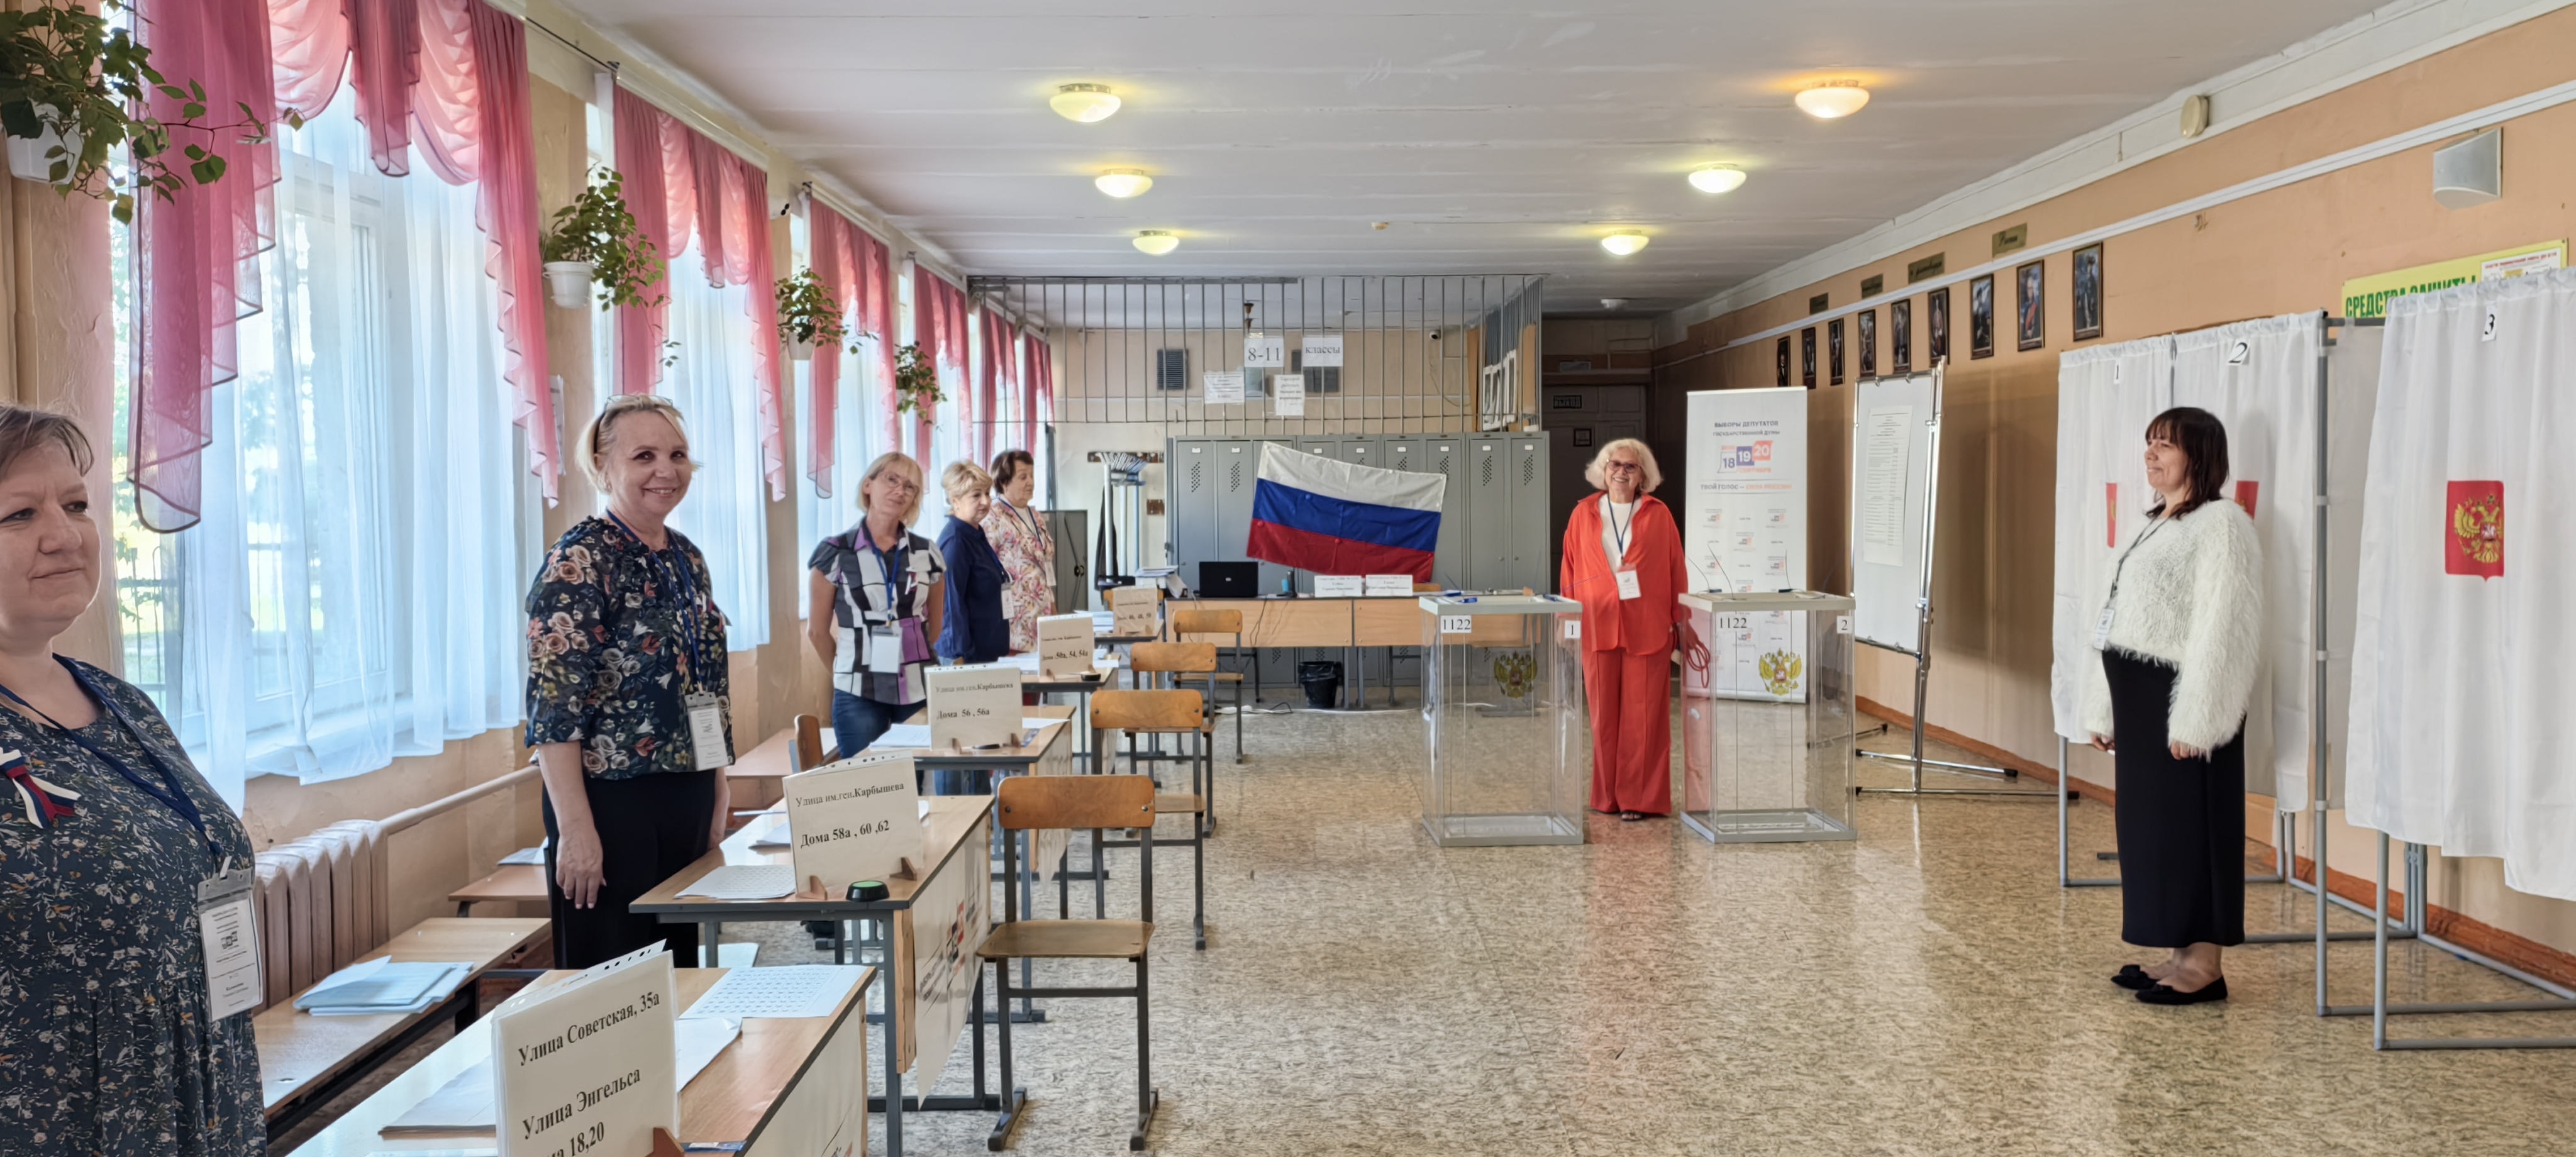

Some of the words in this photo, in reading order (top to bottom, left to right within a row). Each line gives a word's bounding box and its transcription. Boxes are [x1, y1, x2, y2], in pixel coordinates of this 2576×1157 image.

[2484, 314, 2495, 335] 3
[1248, 347, 1280, 362] 8-11
[2228, 342, 2248, 363] 2
[2116, 365, 2119, 380] 1
[1723, 458, 1735, 468] 18
[1738, 451, 1751, 462] 19
[1754, 445, 1770, 457] 20
[1443, 619, 1470, 630] 1122
[1570, 624, 1574, 635] 1
[1720, 617, 1746, 628] 1122
[1841, 619, 1848, 630] 2
[937, 711, 957, 720] Дома
[962, 709, 970, 717] 56
[977, 708, 990, 716] 56а
[796, 797, 823, 807] Улица
[801, 833, 830, 848] Дома
[833, 828, 851, 841] 58а
[860, 823, 872, 835] 60
[518, 1036, 564, 1066] Улица
[567, 1004, 638, 1044] Советская,
[640, 992, 660, 1012] 35а
[523, 1103, 572, 1140] Улица
[577, 1069, 641, 1112] Энгельса
[570, 1121, 604, 1157] 18,20
